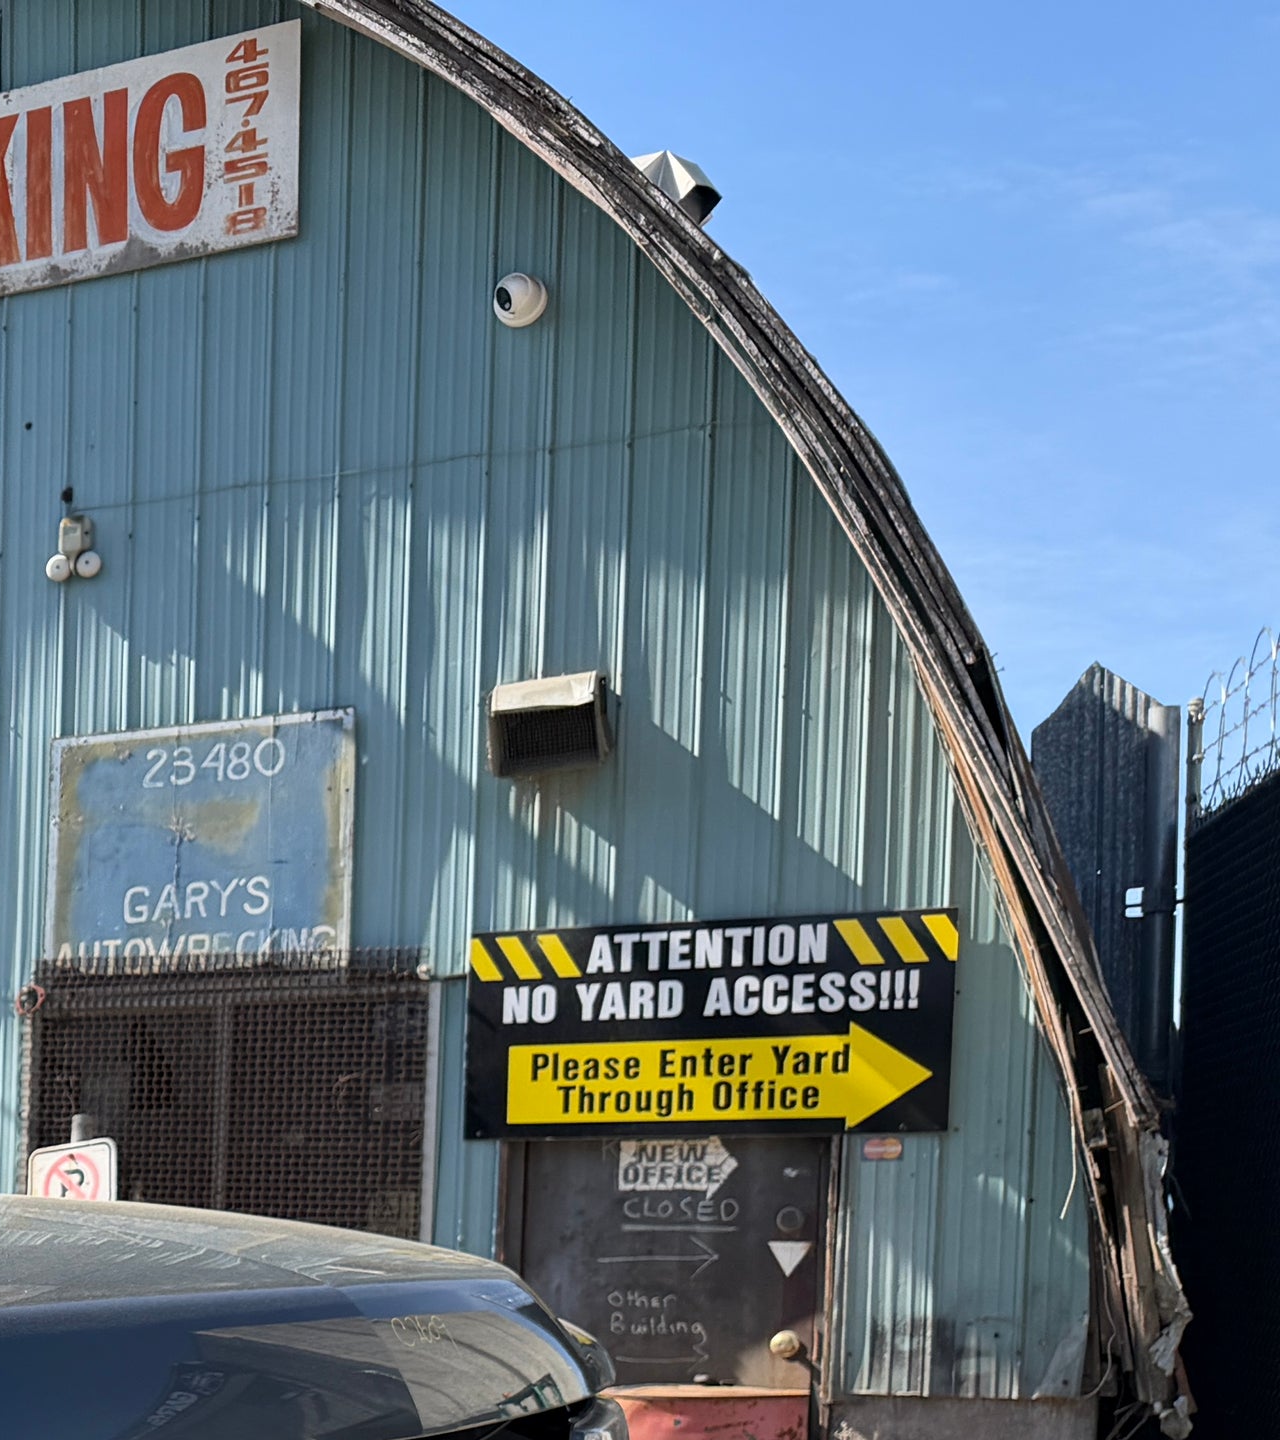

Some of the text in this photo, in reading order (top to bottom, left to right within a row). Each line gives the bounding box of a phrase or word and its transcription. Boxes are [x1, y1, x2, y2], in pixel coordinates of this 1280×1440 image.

[142, 737, 286, 789] 23480
[123, 875, 271, 924] GARY'S
[586, 922, 829, 975] ATTENTION
[502, 969, 921, 1025] NO YARD ACCESS!!!
[530, 1043, 851, 1082] Please Enter Yard
[557, 1081, 820, 1118] Through Office
[635, 1142, 707, 1162] NEW
[623, 1164, 722, 1185] OFFICE
[623, 1196, 739, 1222] CLOSED
[607, 1290, 677, 1309] Other
[610, 1311, 707, 1348] Building
